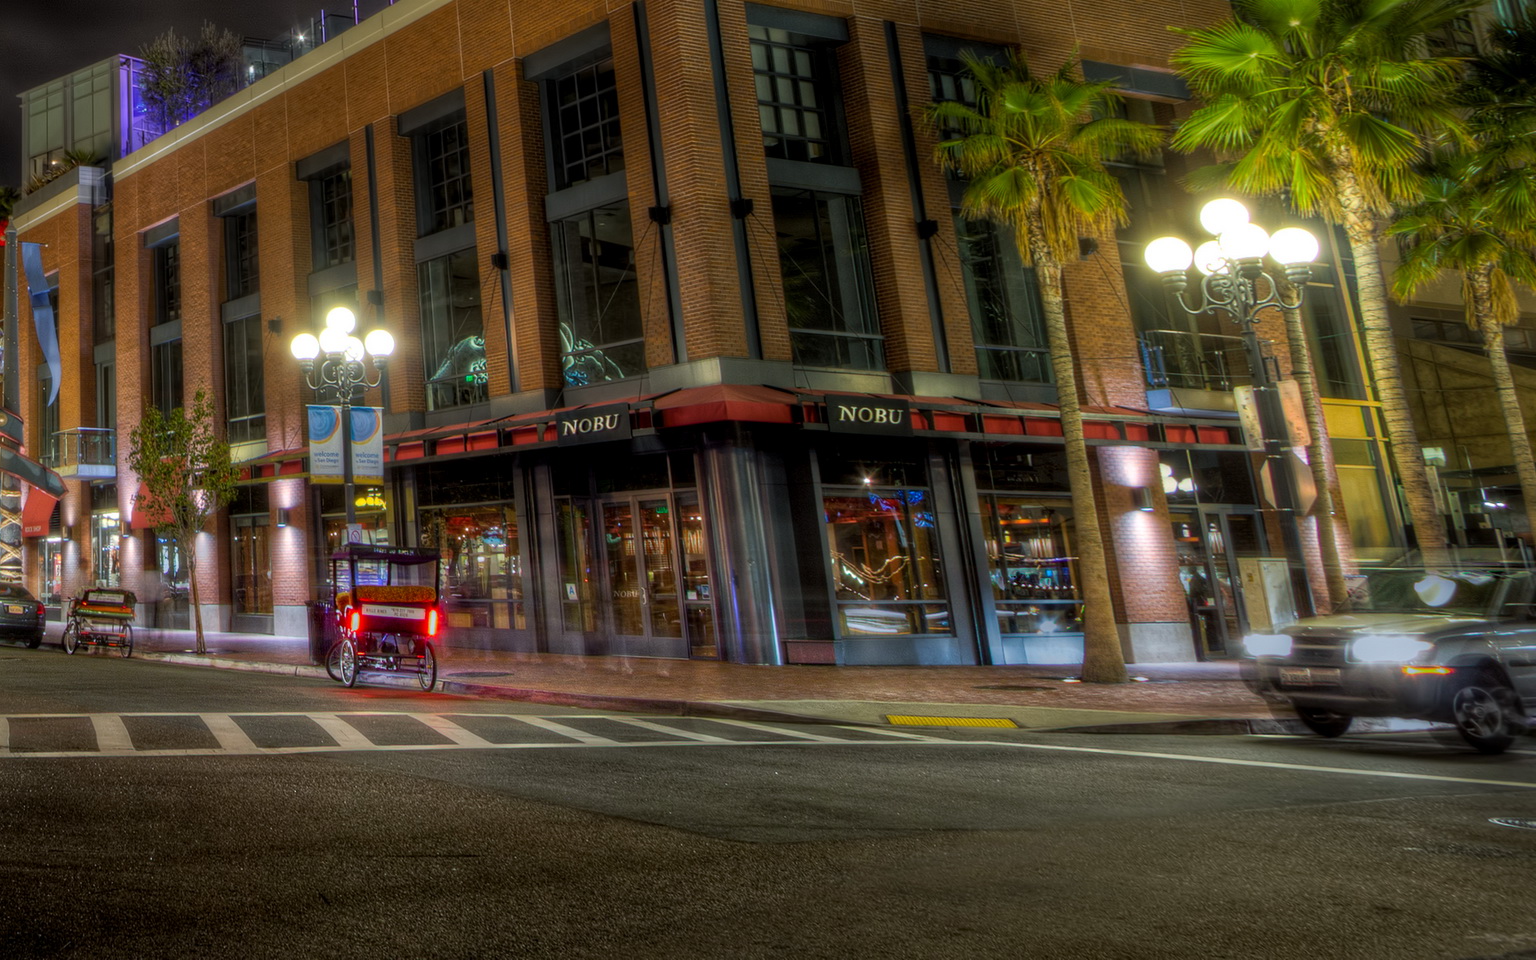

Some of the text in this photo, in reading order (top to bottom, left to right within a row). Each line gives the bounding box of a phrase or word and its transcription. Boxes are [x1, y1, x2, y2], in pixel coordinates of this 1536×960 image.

[838, 405, 904, 424] NOBU
[562, 414, 619, 436] NOBU
[614, 590, 638, 598] NOBU
